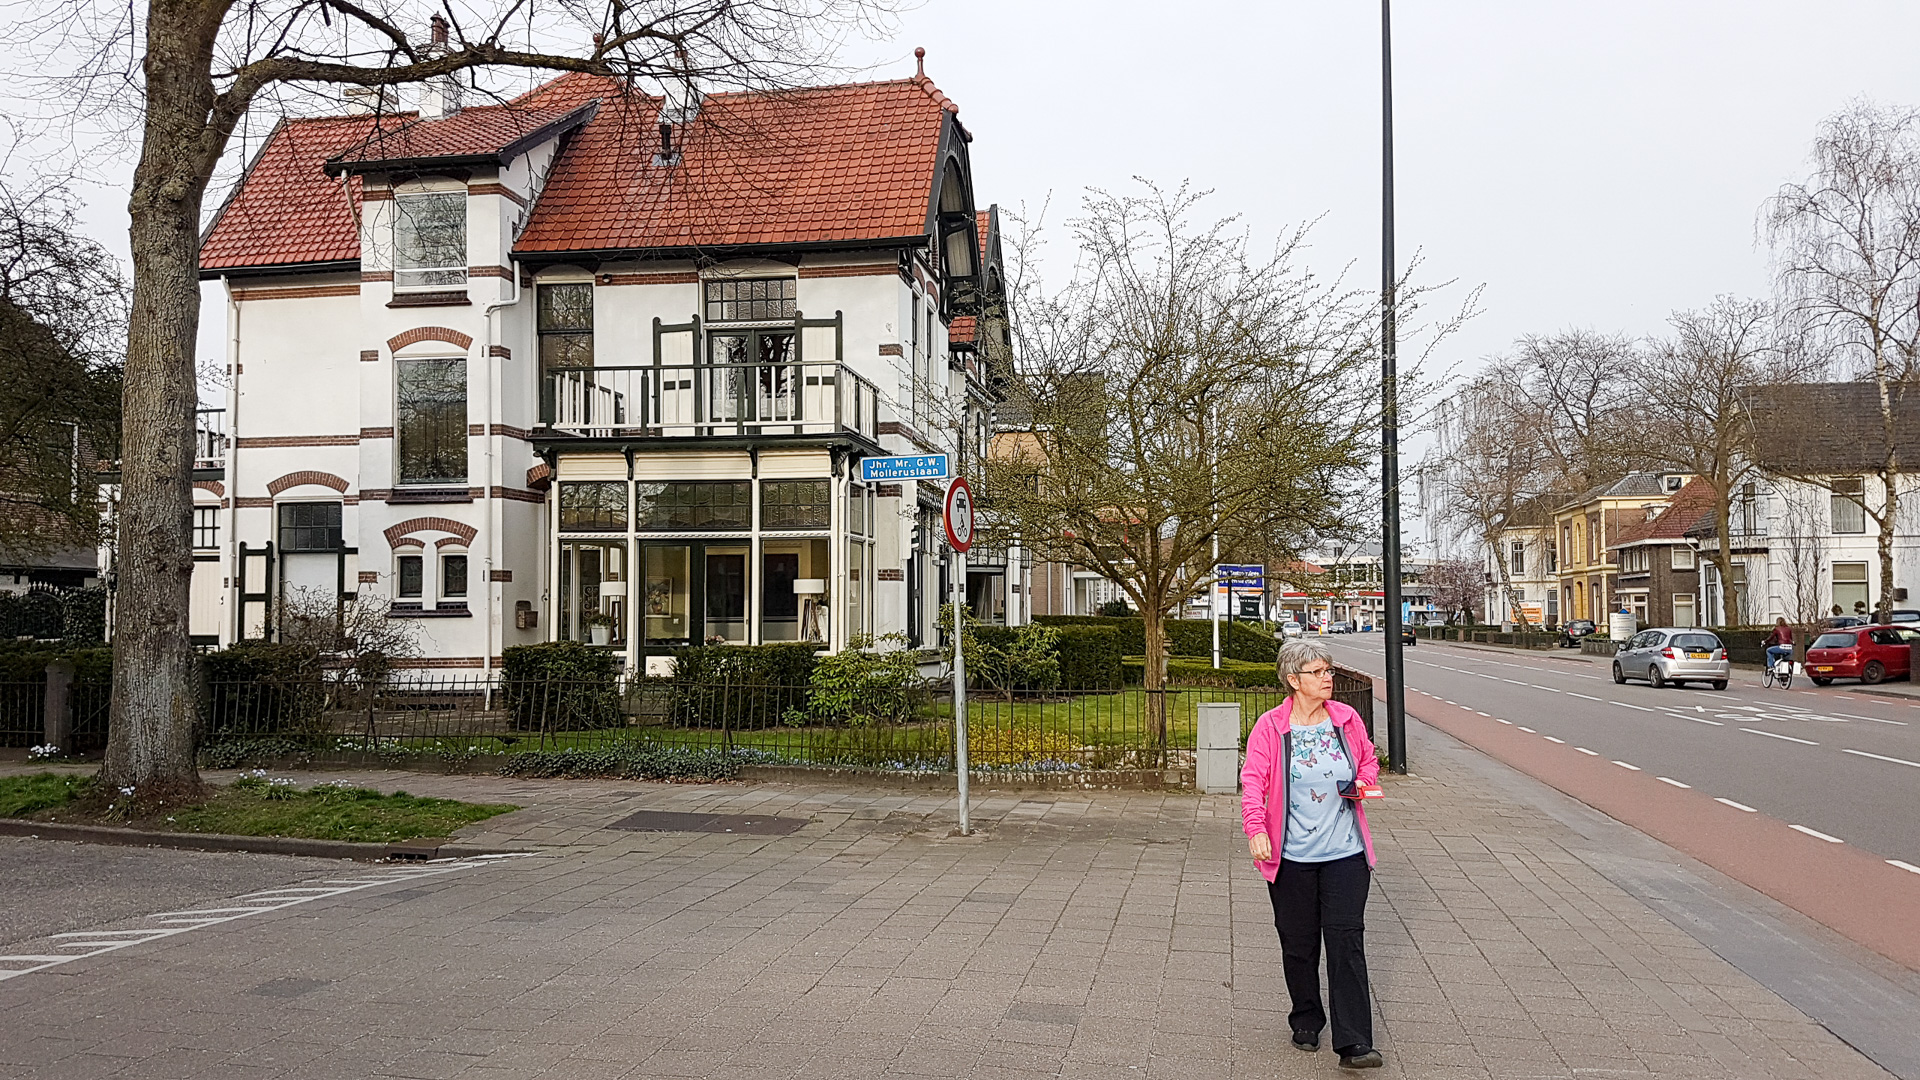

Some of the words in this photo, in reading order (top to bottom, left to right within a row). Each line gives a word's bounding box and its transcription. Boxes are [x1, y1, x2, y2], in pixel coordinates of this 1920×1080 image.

[869, 460, 890, 469] Jhr.
[895, 459, 912, 468] Mr.
[916, 457, 940, 467] G.W.
[870, 467, 939, 478] Molleruslaan
